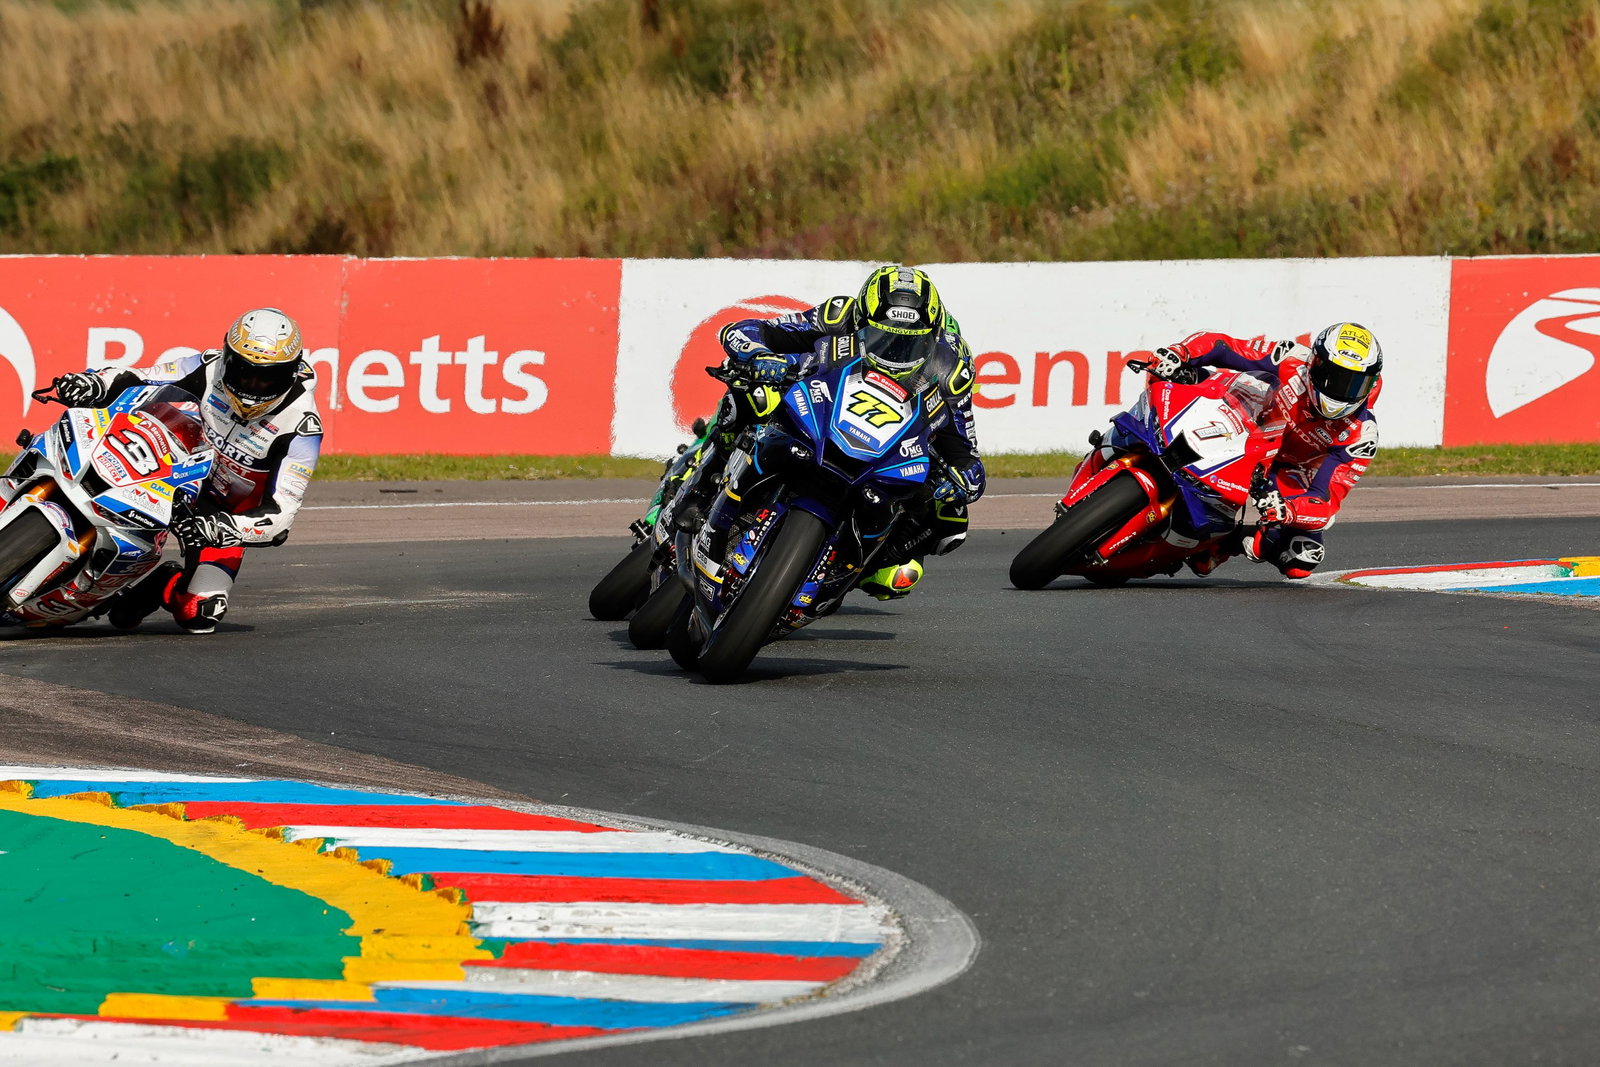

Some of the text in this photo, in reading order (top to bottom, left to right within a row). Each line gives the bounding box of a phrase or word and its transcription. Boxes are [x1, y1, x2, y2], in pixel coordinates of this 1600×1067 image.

[891, 310, 916, 319] SHOEI
[1340, 329, 1370, 344] ATLAS
[1341, 349, 1360, 360] HJC
[86, 326, 548, 415] Bnetts
[879, 377, 906, 398] Bennetts
[1284, 386, 1295, 401] RK
[793, 389, 809, 417] YAMAHA
[846, 390, 905, 429] 77
[150, 426, 168, 454] Bennetts
[849, 427, 871, 444] YAMAHA
[1193, 421, 1229, 441] 1
[98, 455, 122, 482] DIRECT
[101, 450, 127, 479] SPORTS
[899, 463, 926, 478] YAMAHA
